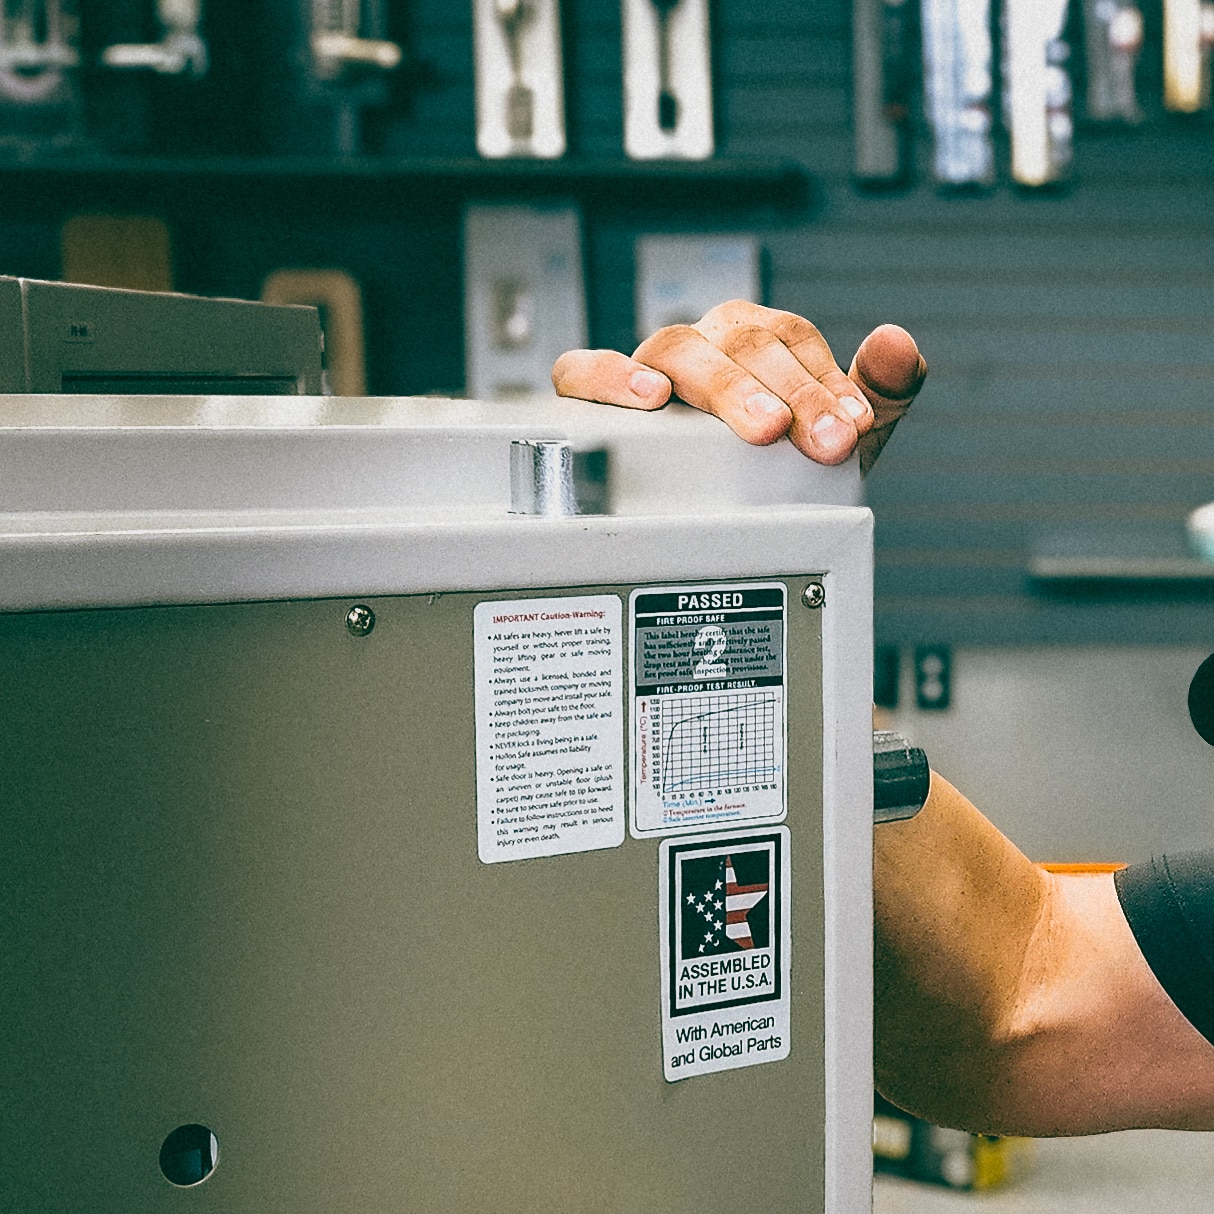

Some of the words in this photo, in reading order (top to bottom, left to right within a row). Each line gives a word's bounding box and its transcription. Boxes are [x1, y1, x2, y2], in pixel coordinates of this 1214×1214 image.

[678, 593, 743, 609] PASSED
[493, 614, 539, 623] IMPORTANT
[541, 610, 605, 620] Caution-Warning:
[677, 616, 703, 624] PROOF
[706, 682, 724, 690] TEST
[680, 954, 771, 981] ASSEMBLED
[678, 985, 694, 999] IN
[699, 979, 726, 995] THE
[731, 972, 772, 990] U.S.A.
[676, 1025, 707, 1044] With
[711, 1016, 775, 1039] American
[671, 1049, 695, 1068] and
[699, 1040, 743, 1062] Global
[747, 1035, 782, 1053] Parts
